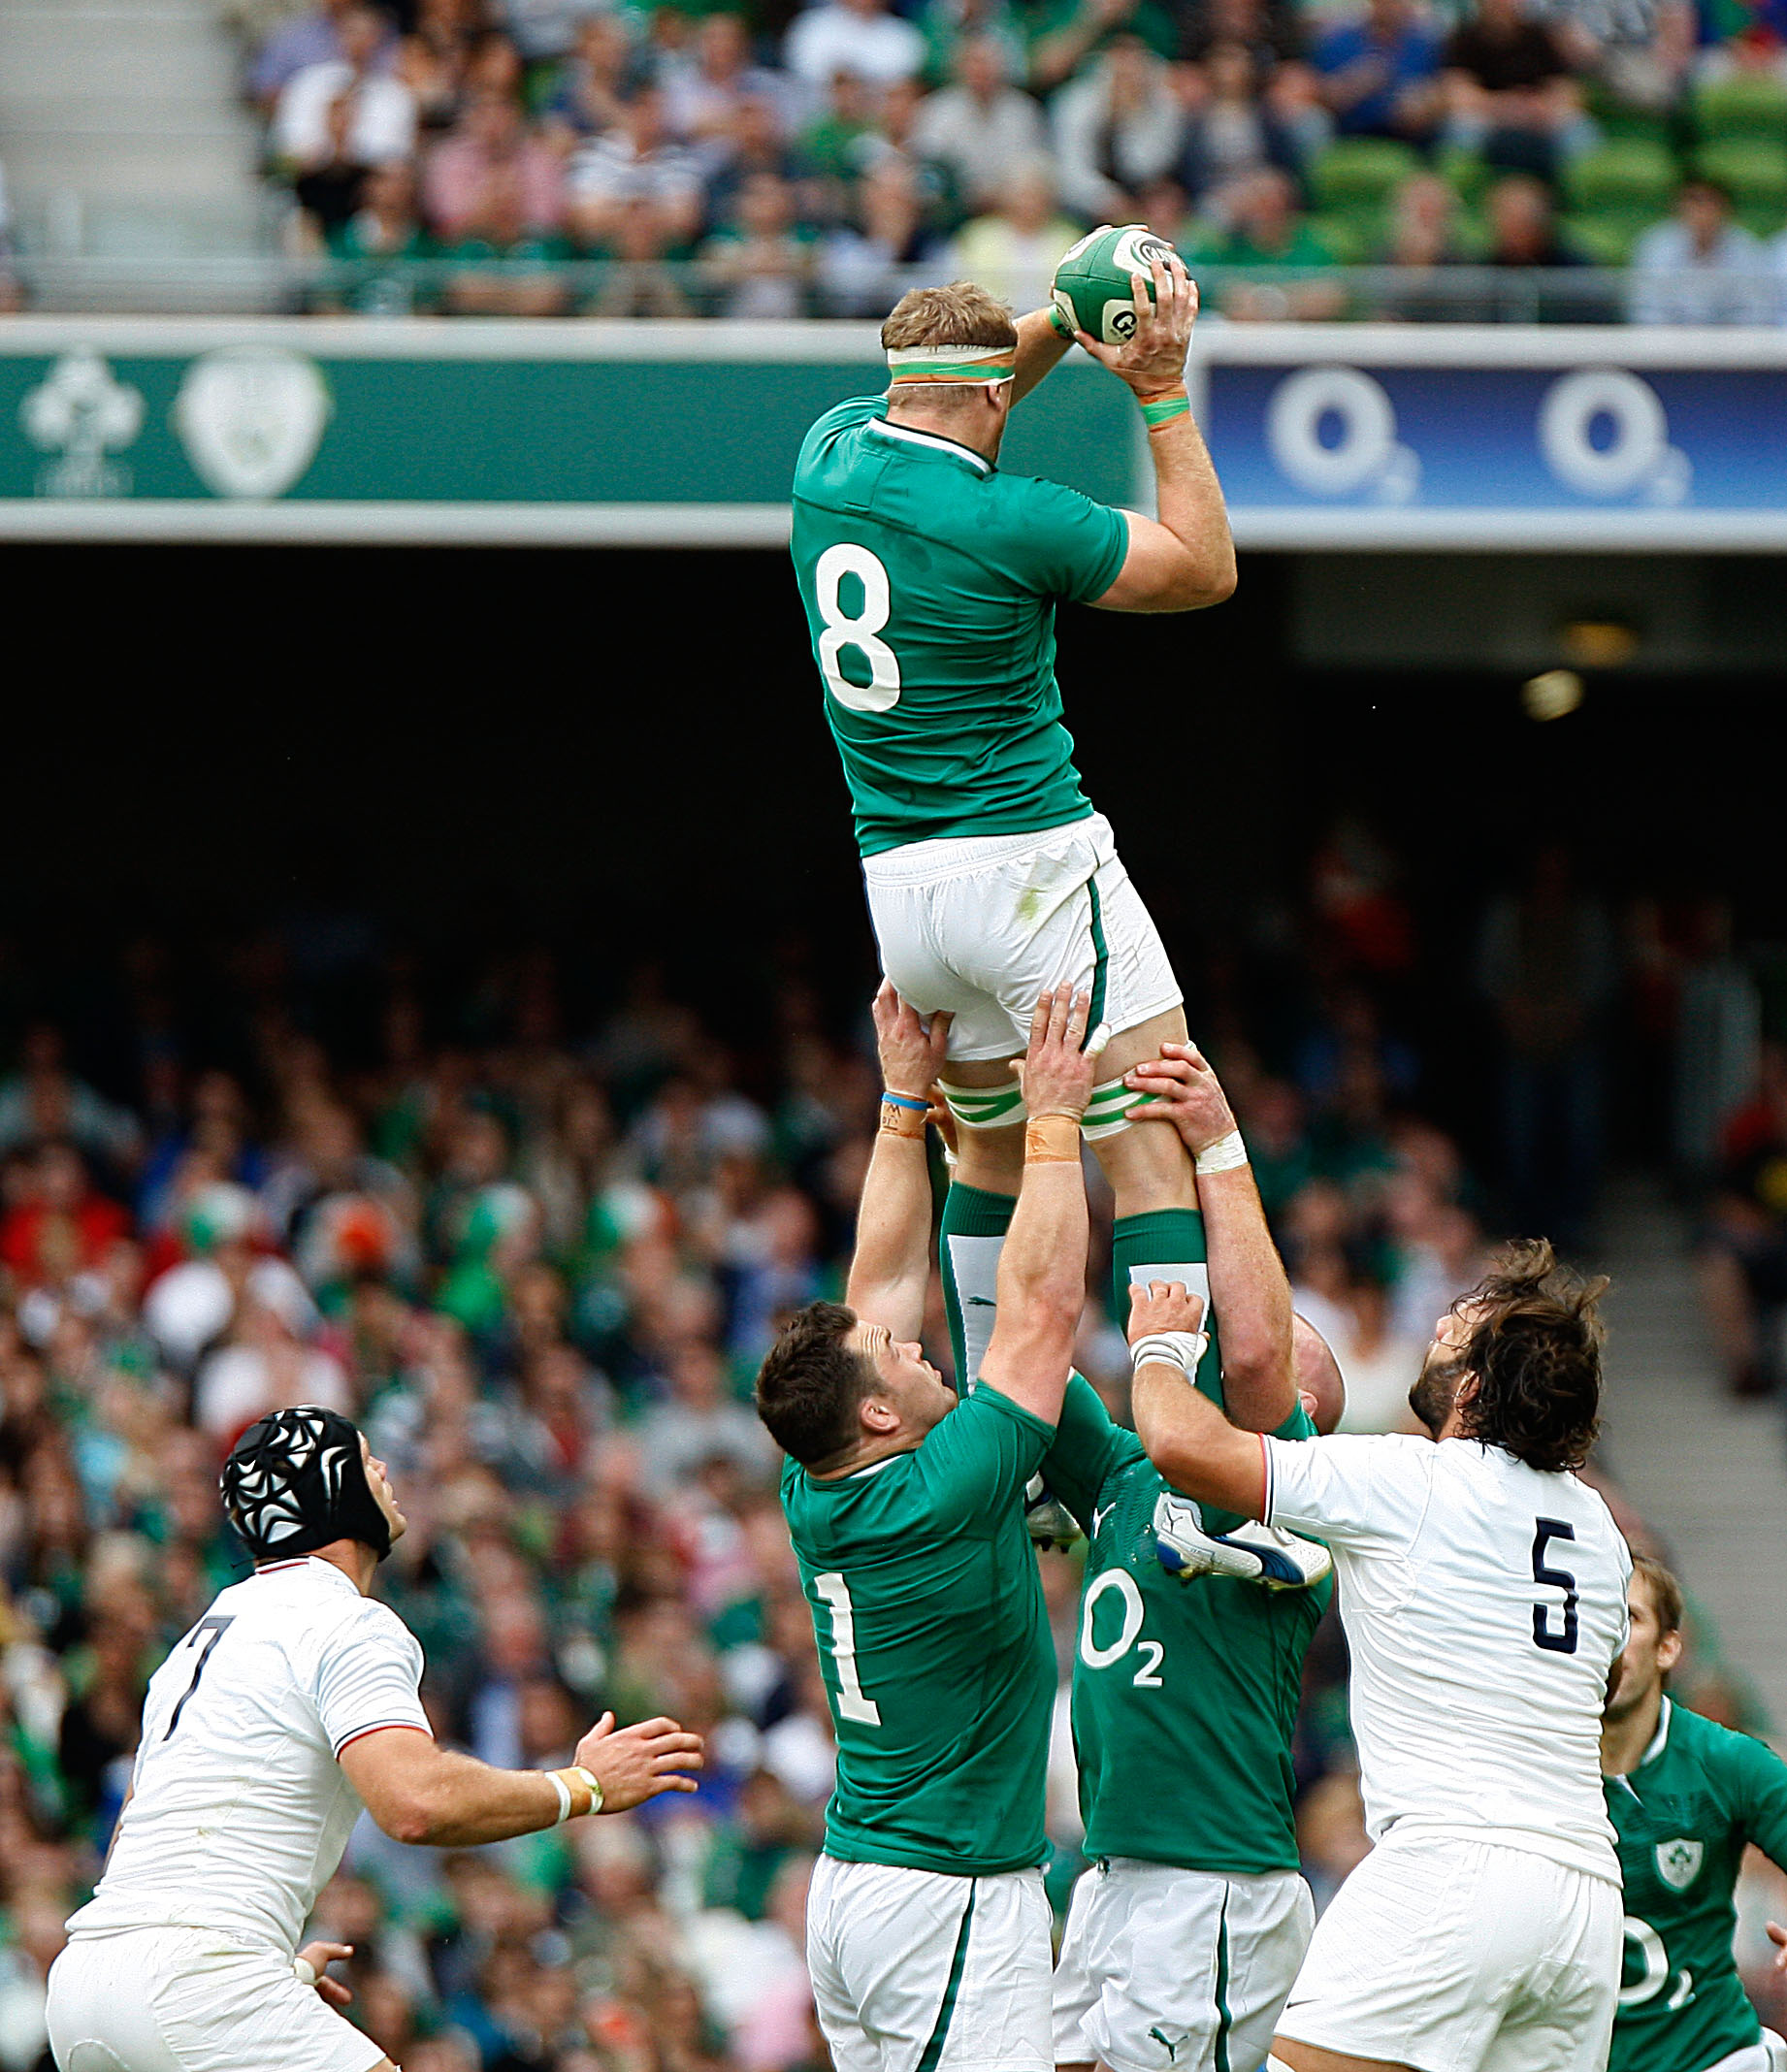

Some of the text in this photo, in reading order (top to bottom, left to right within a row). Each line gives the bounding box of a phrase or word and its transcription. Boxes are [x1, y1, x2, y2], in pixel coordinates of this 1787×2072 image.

[816, 542, 901, 713] 8
[813, 1571, 882, 1727] 1
[1081, 1568, 1164, 1689] O2
[1532, 1515, 1580, 1655] 5
[161, 1615, 238, 1742] 7
